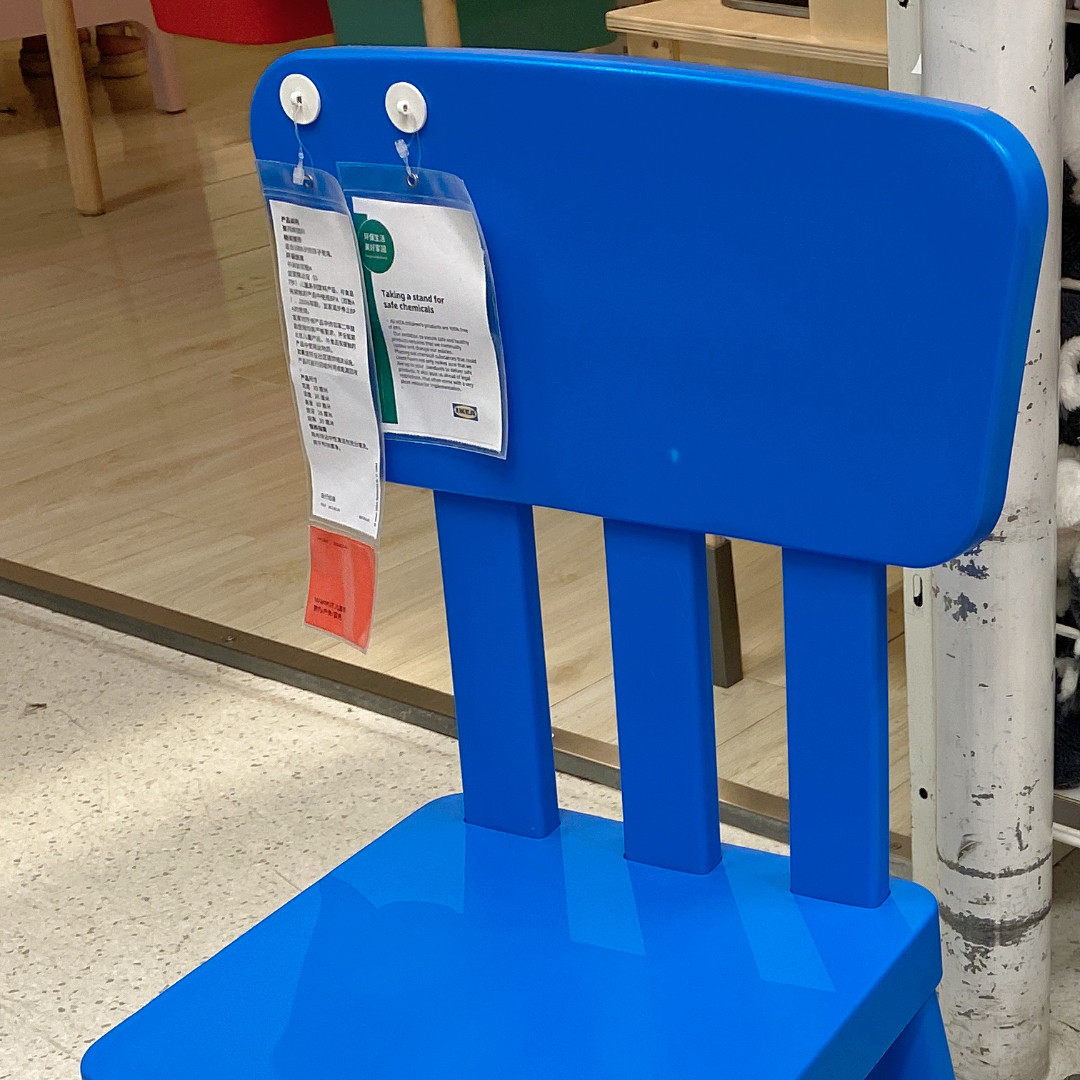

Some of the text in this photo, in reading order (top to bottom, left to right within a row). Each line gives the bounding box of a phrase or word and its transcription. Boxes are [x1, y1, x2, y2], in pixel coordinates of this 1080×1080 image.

[381, 289, 406, 302] Taking
[412, 294, 433, 303] stand
[433, 294, 445, 304] for
[383, 301, 435, 314] safe chemicals
[455, 407, 476, 417] IKEA
